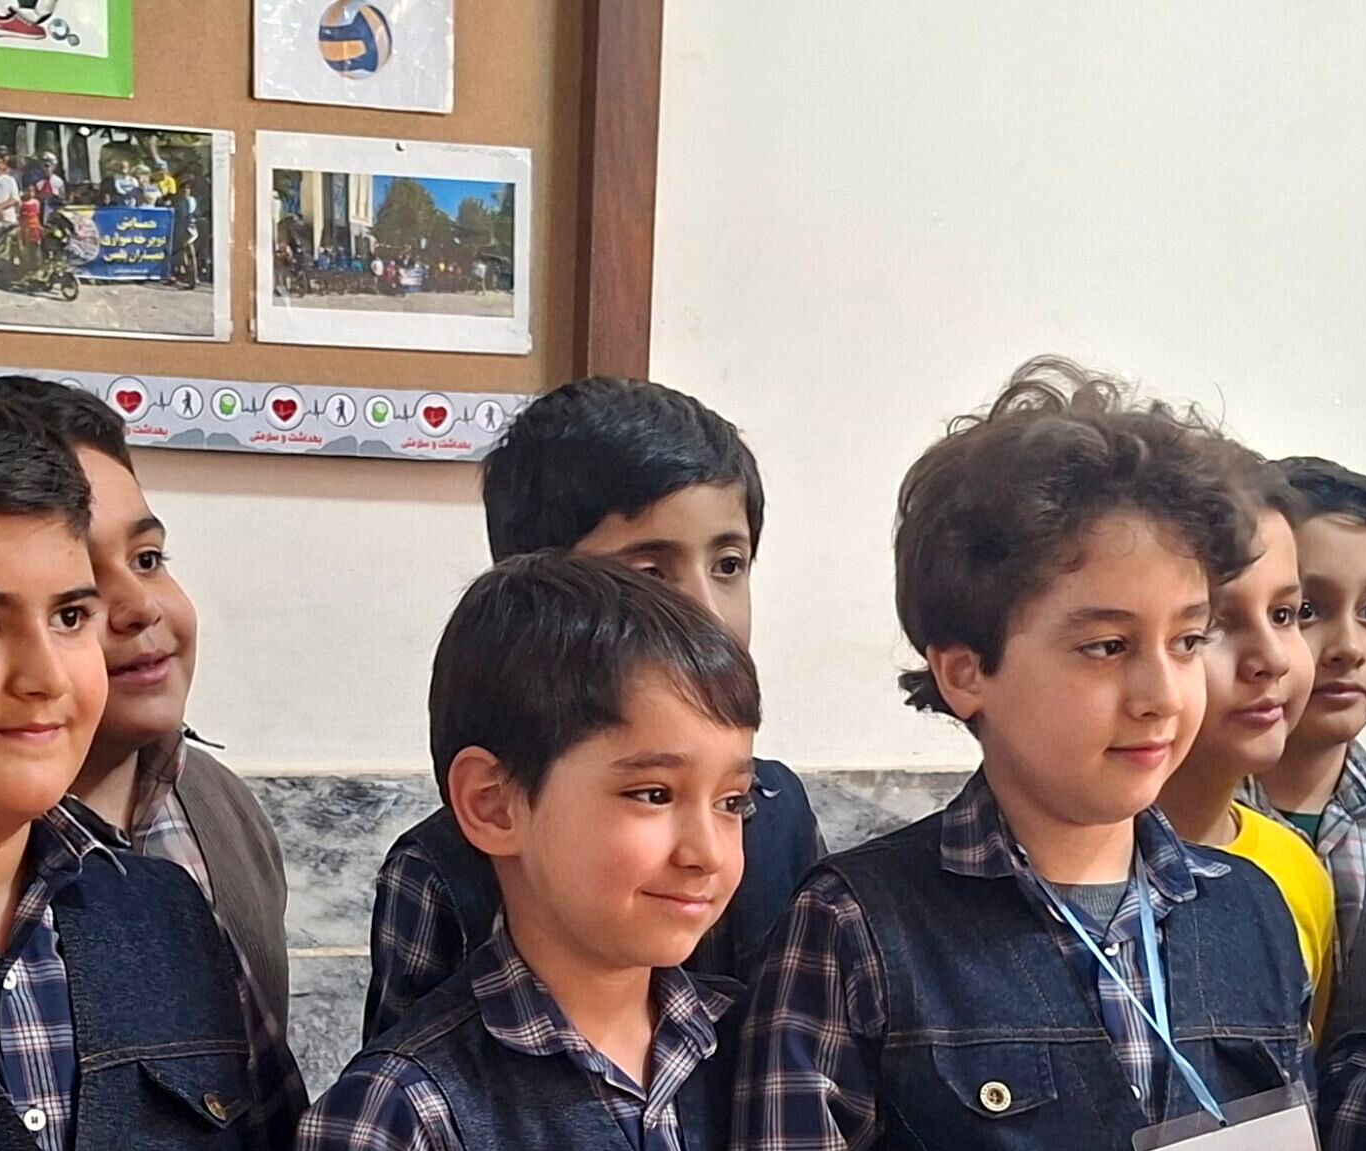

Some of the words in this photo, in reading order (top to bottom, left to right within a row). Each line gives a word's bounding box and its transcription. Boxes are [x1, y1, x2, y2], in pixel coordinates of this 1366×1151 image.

[133, 424, 168, 438] بهداشت
[250, 431, 279, 443] سلامتی
[288, 432, 324, 444] بهداشت
[401, 438, 430, 449] سلامتی
[438, 438, 472, 450] بهداشت
